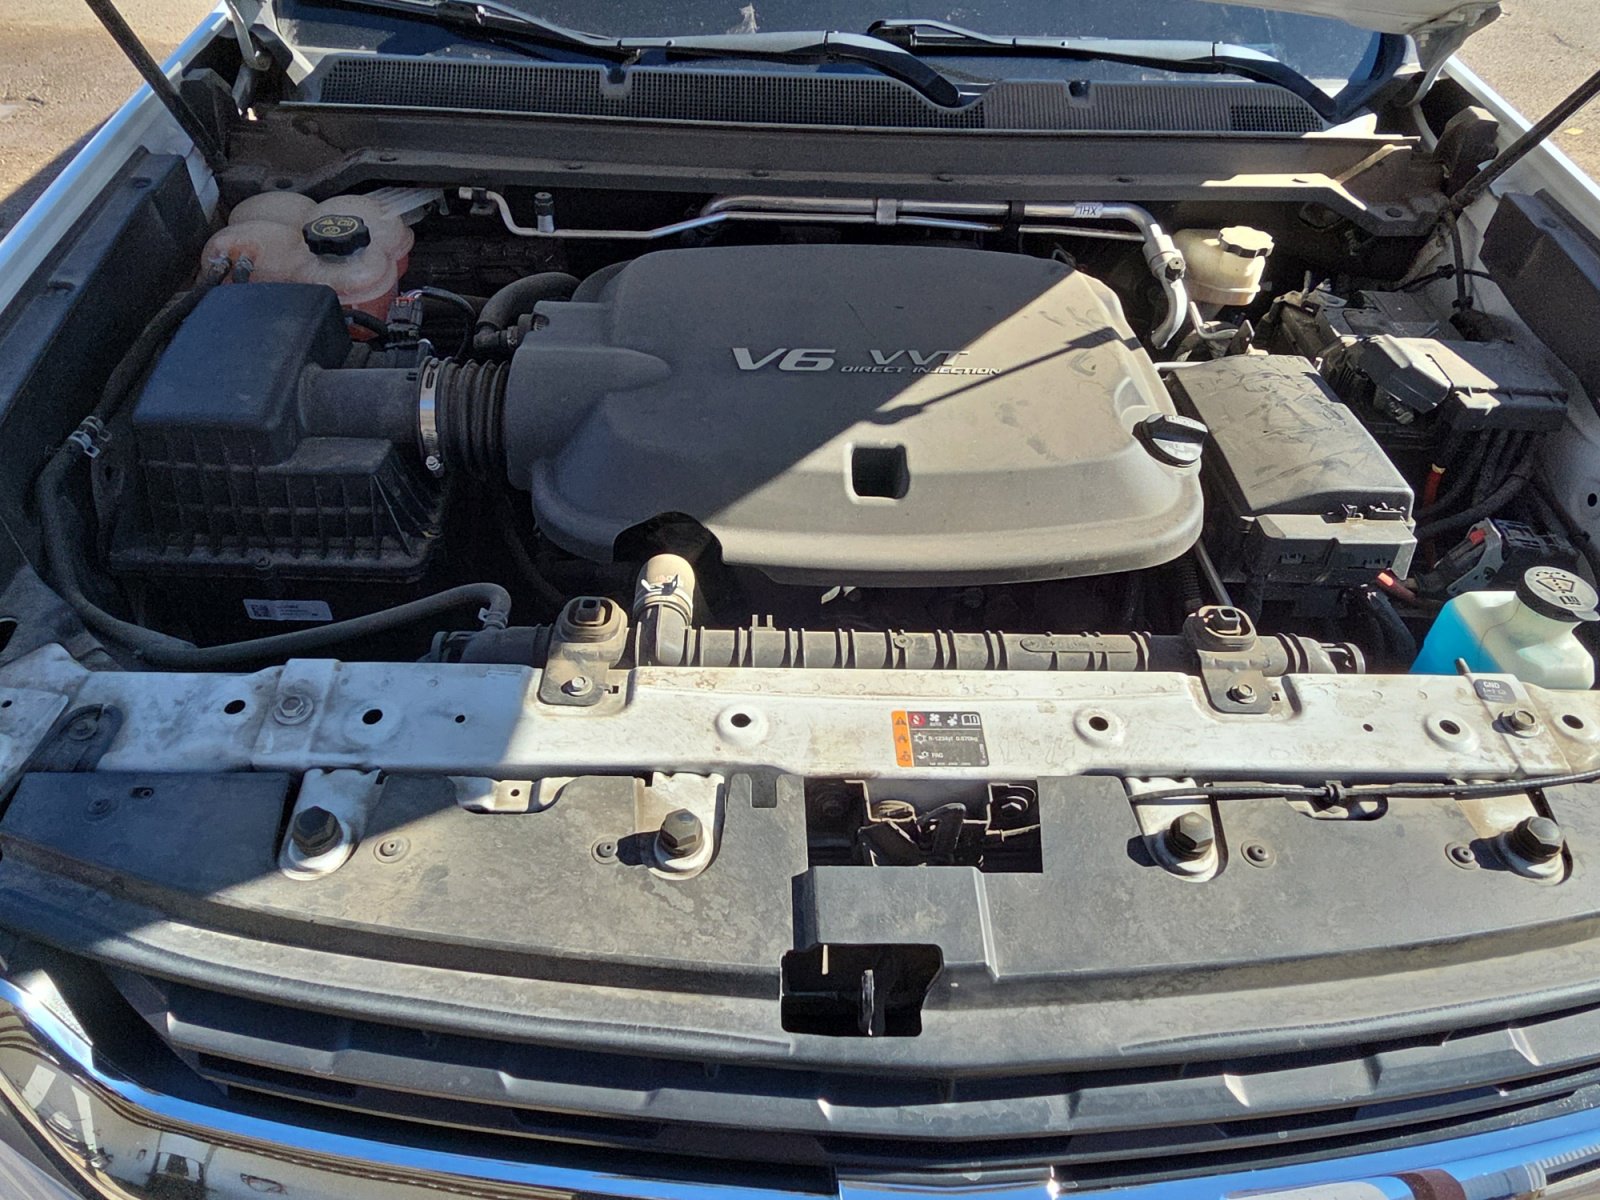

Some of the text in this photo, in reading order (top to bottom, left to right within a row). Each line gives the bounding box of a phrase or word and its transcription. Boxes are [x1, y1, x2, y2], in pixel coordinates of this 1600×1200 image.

[732, 347, 836, 371] V6
[869, 350, 969, 366] VVT
[912, 367, 1002, 375] INJECTION
